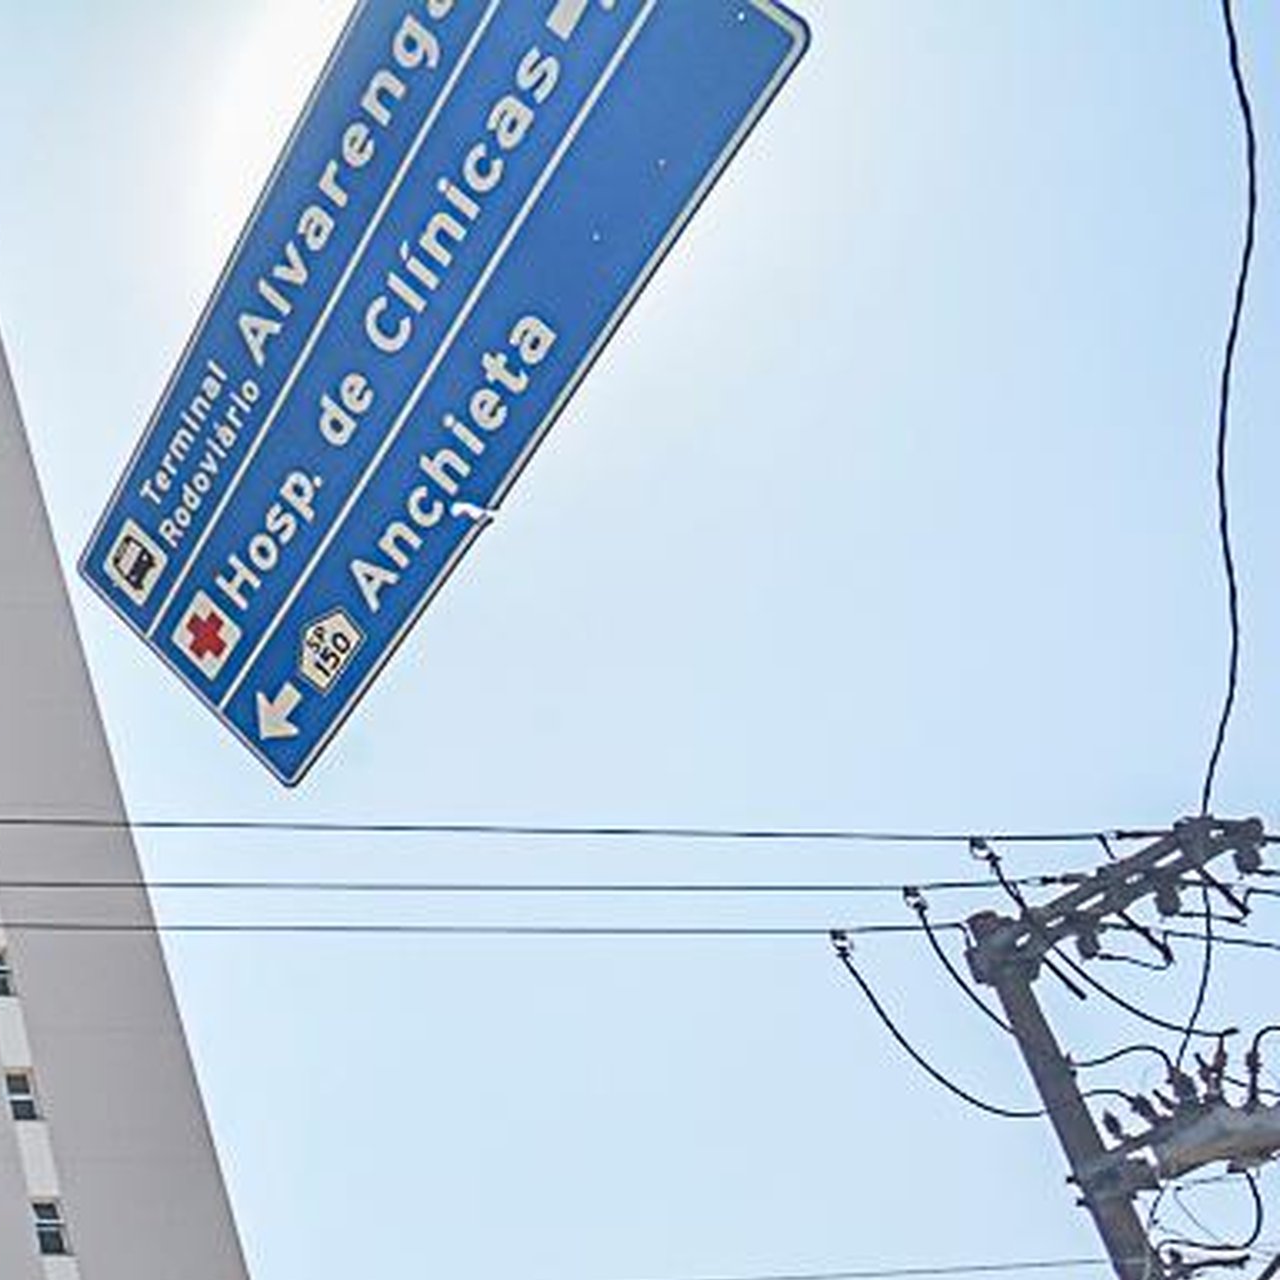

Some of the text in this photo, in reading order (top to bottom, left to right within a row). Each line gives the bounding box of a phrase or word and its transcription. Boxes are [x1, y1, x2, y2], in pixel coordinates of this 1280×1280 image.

[215, 47, 560, 610] Hosp. de Clínicas
[143, 361, 228, 506] Terminal
[161, 380, 260, 548] Rodoviário
[350, 314, 557, 611] Anchieta
[306, 626, 326, 653] SP
[315, 633, 350, 677] 150
